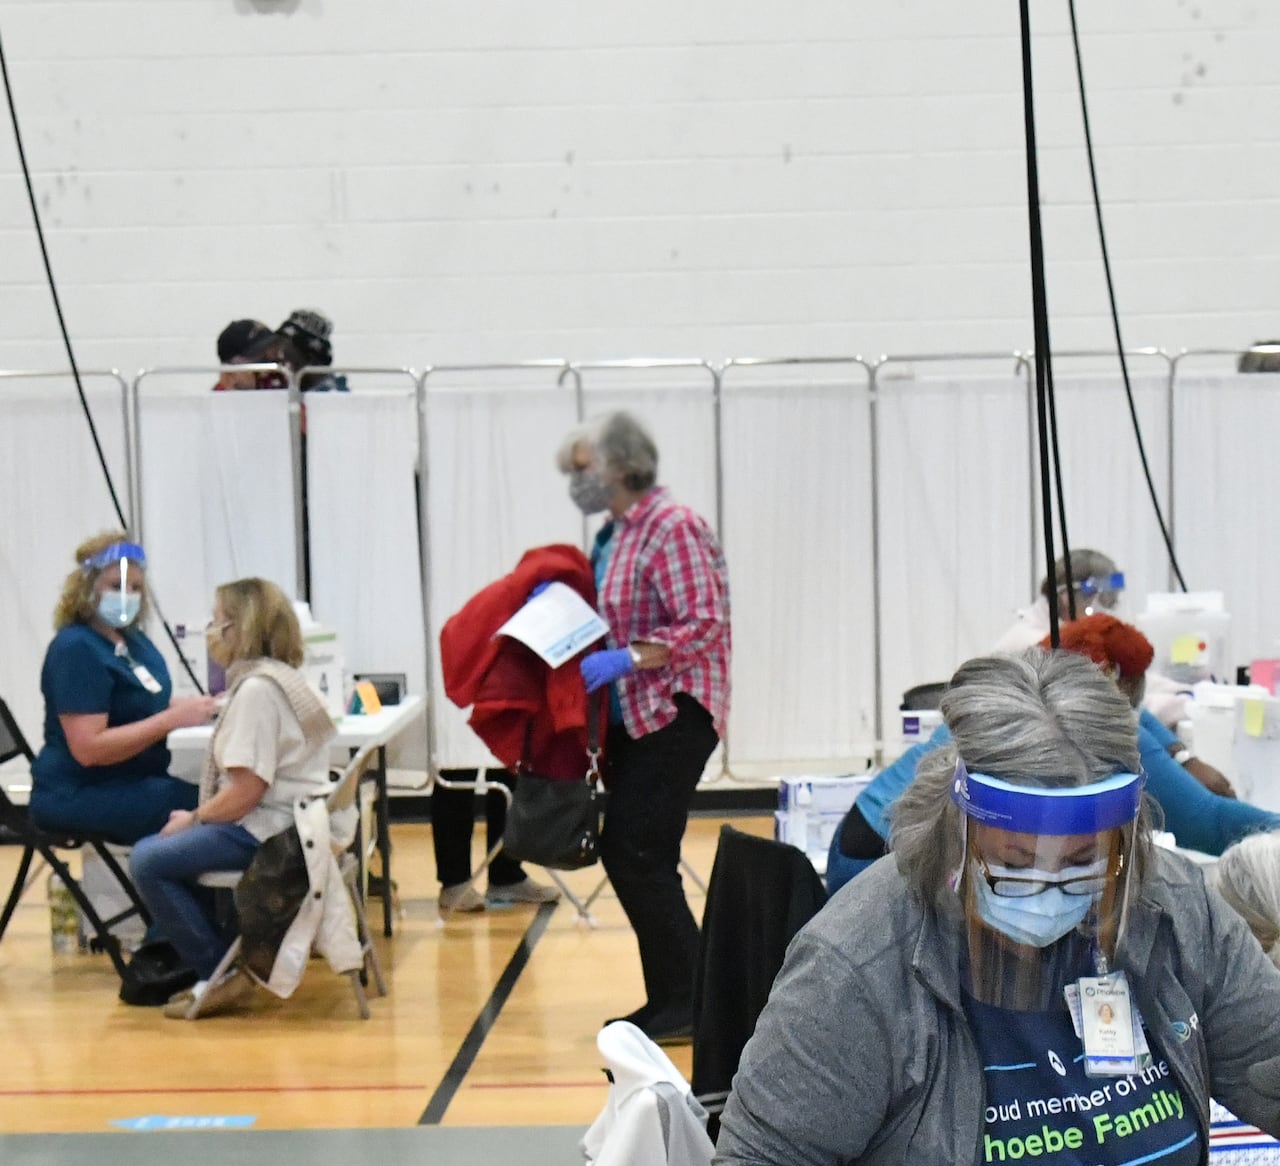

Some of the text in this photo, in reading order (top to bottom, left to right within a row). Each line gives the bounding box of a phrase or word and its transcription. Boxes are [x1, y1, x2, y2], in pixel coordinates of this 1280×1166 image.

[984, 1060, 1170, 1124] oud member of the
[984, 1089, 1186, 1163] hoebe Family
